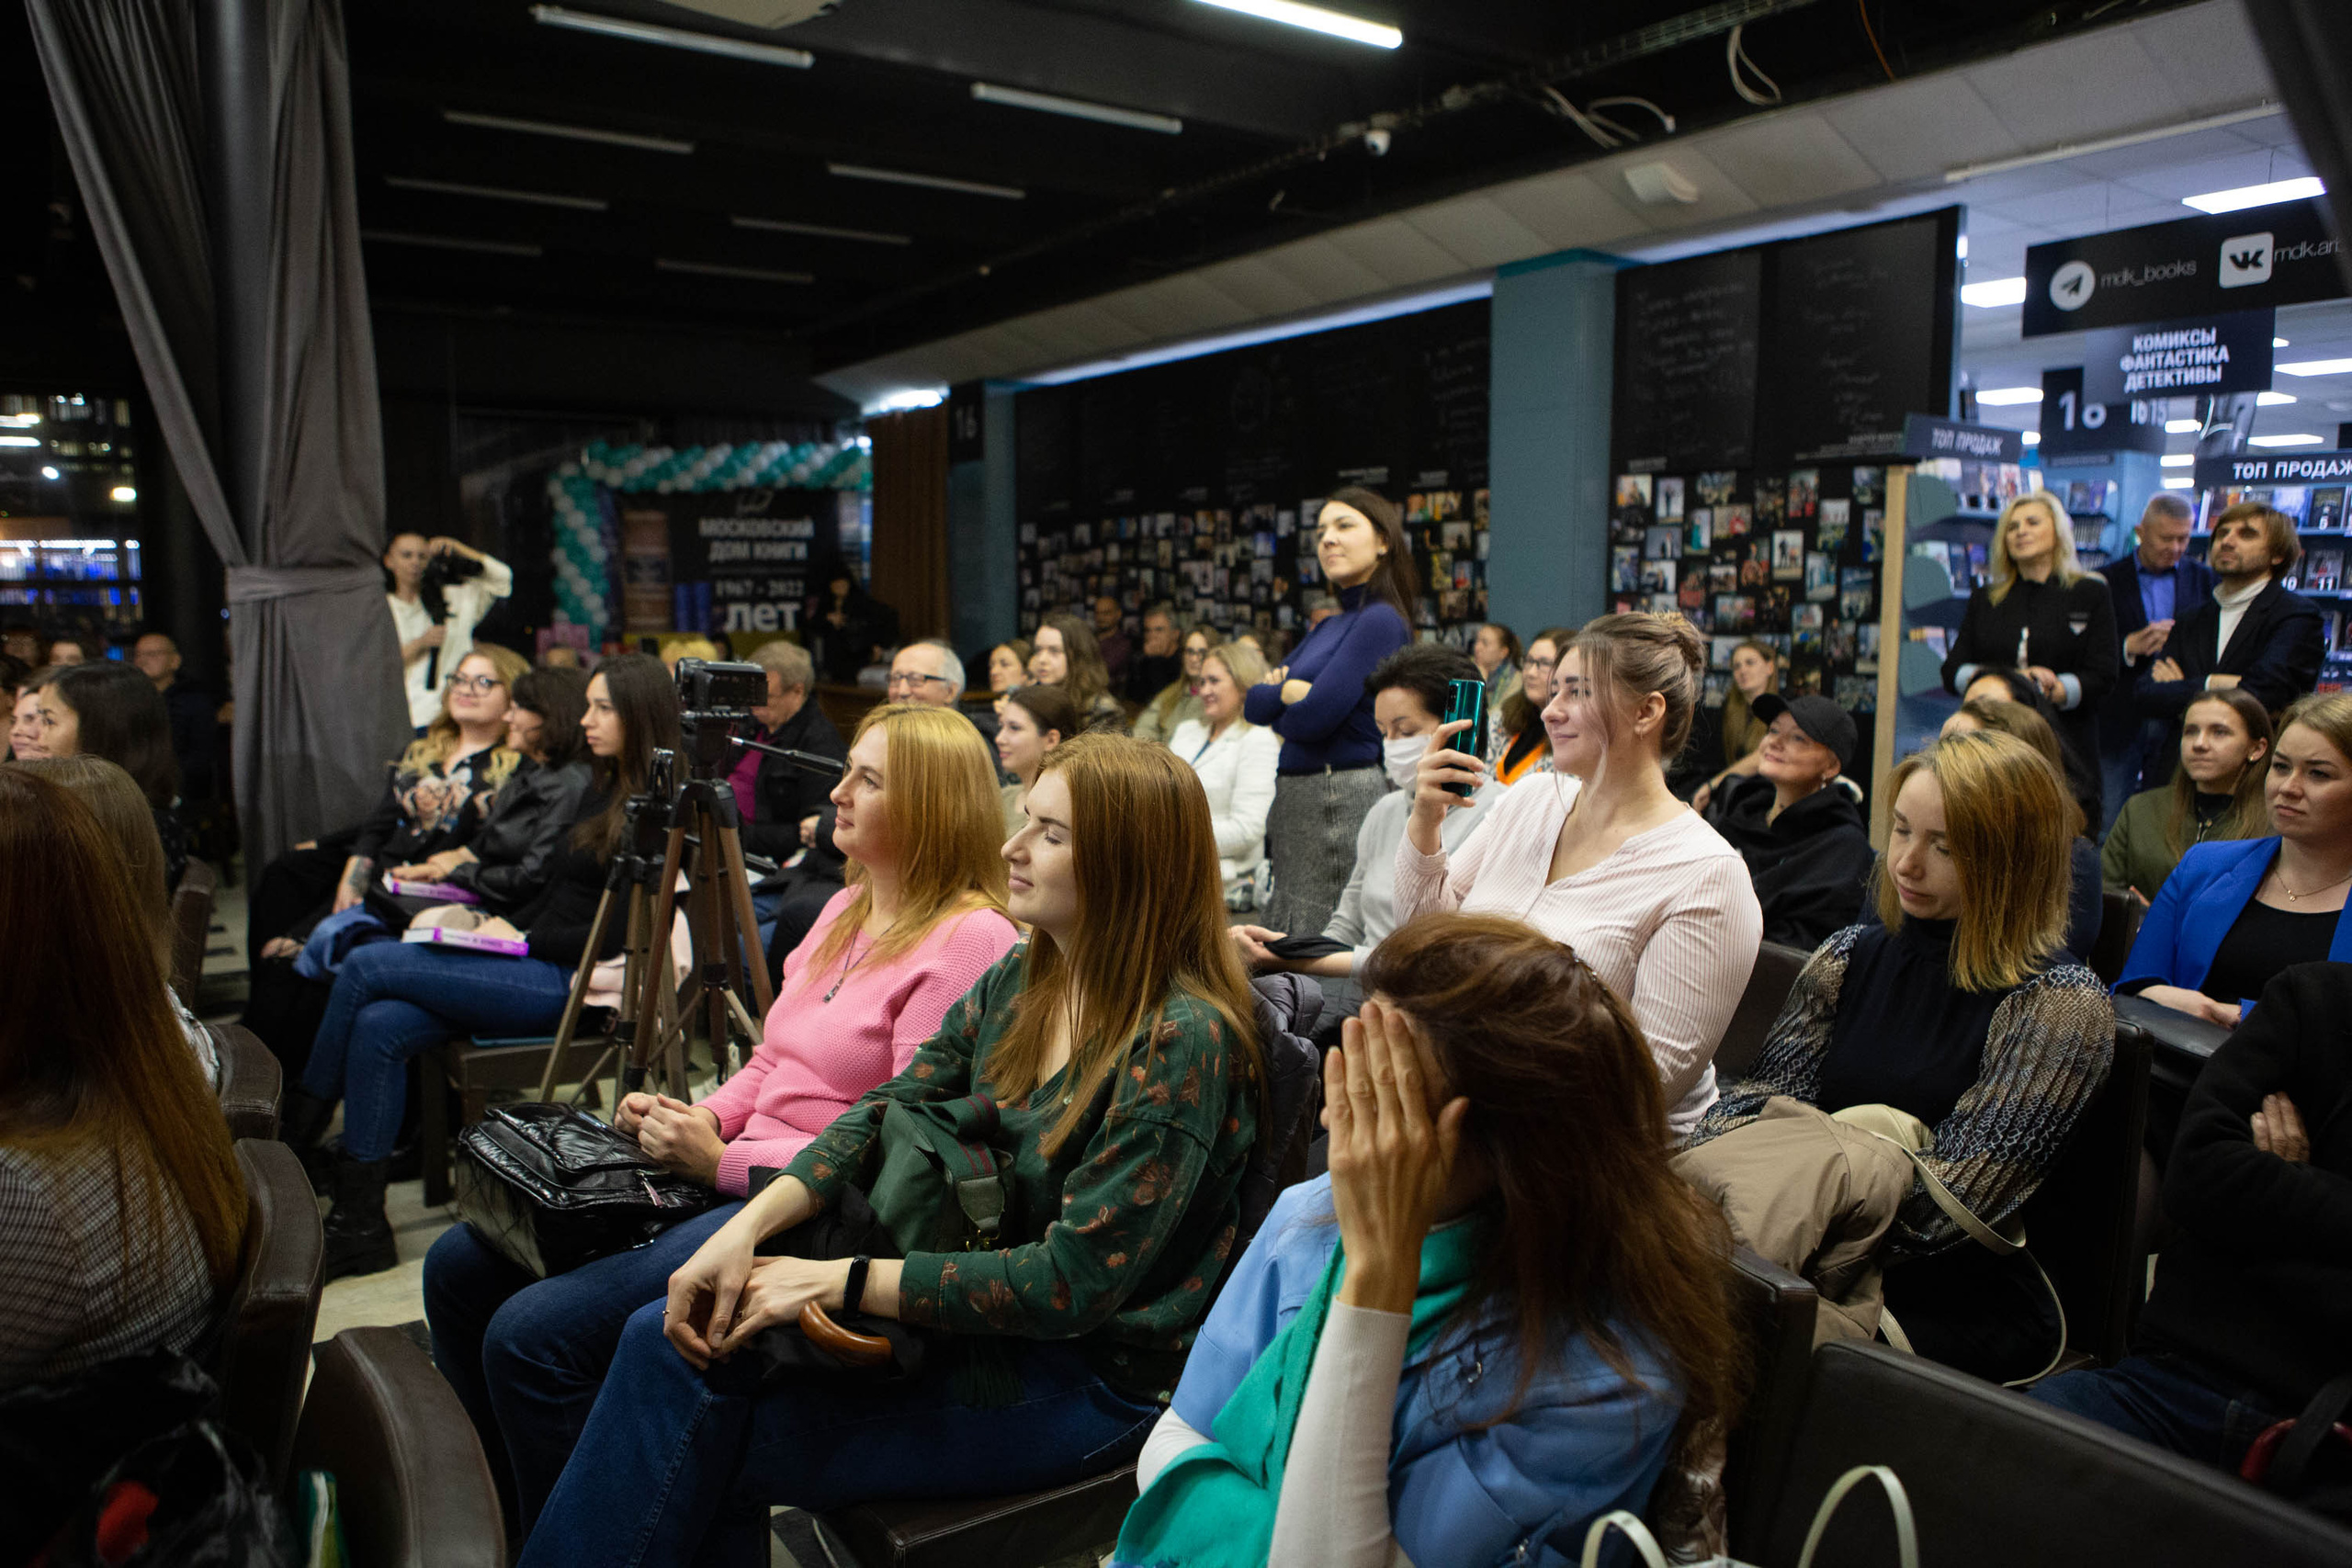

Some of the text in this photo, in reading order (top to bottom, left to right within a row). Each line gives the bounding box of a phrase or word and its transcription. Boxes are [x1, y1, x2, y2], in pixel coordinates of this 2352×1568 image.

[2100, 259, 2198, 288] mdk_books
[2132, 327, 2217, 353] КОМИКСЫ
[2120, 344, 2230, 372] ФАНТАСТИКА
[2124, 365, 2222, 393] ДЕТЕКТИВЫ
[1932, 427, 1955, 450] ТОП
[1954, 431, 2003, 457] ПРОДАЖ
[2233, 459, 2352, 479] ТОП ПРОДАЖ
[2280, 576, 2298, 592] 10
[2317, 577, 2334, 592] 11
[724, 602, 801, 634] лет
